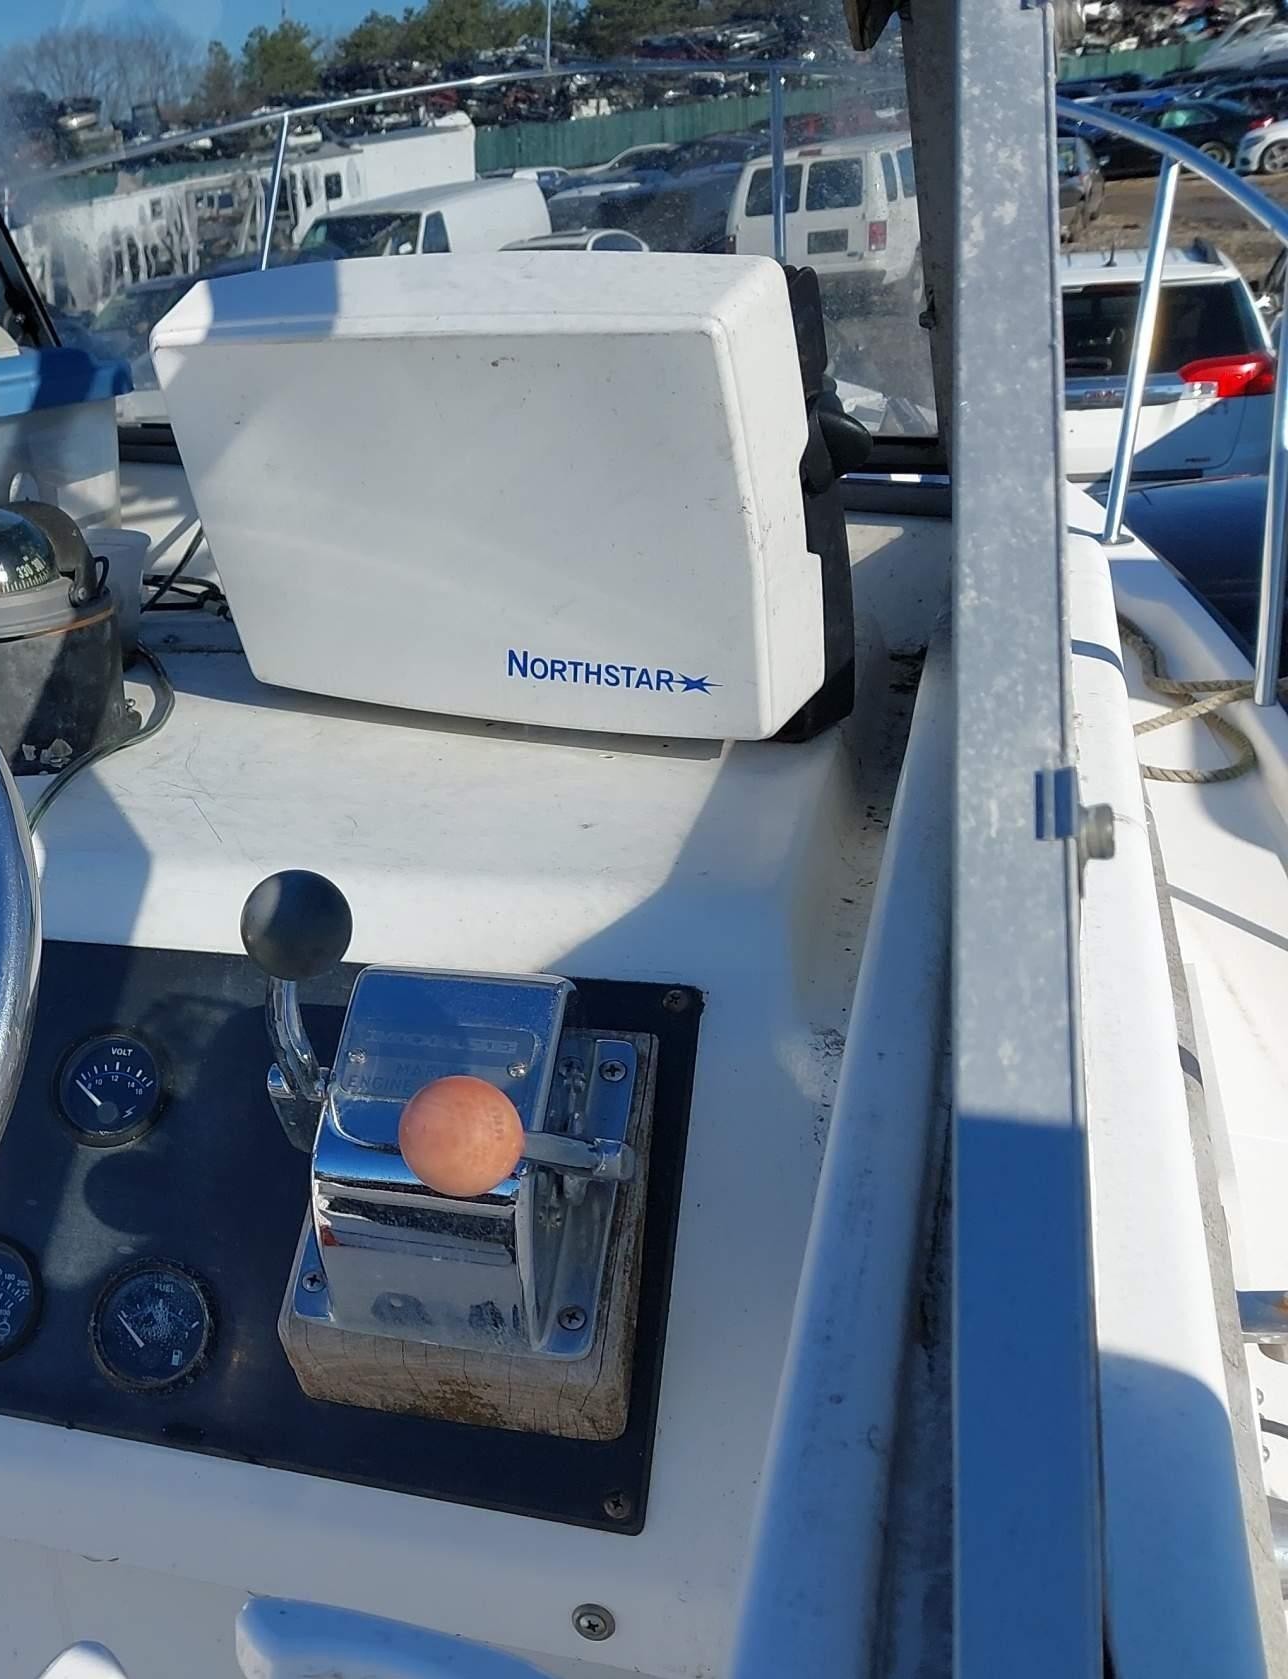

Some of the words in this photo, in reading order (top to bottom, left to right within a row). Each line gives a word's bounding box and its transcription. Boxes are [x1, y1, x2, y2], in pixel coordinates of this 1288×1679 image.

[16, 565, 33, 579] 330
[112, 1047, 133, 1056] VOLT
[154, 1283, 175, 1293] FUEL
